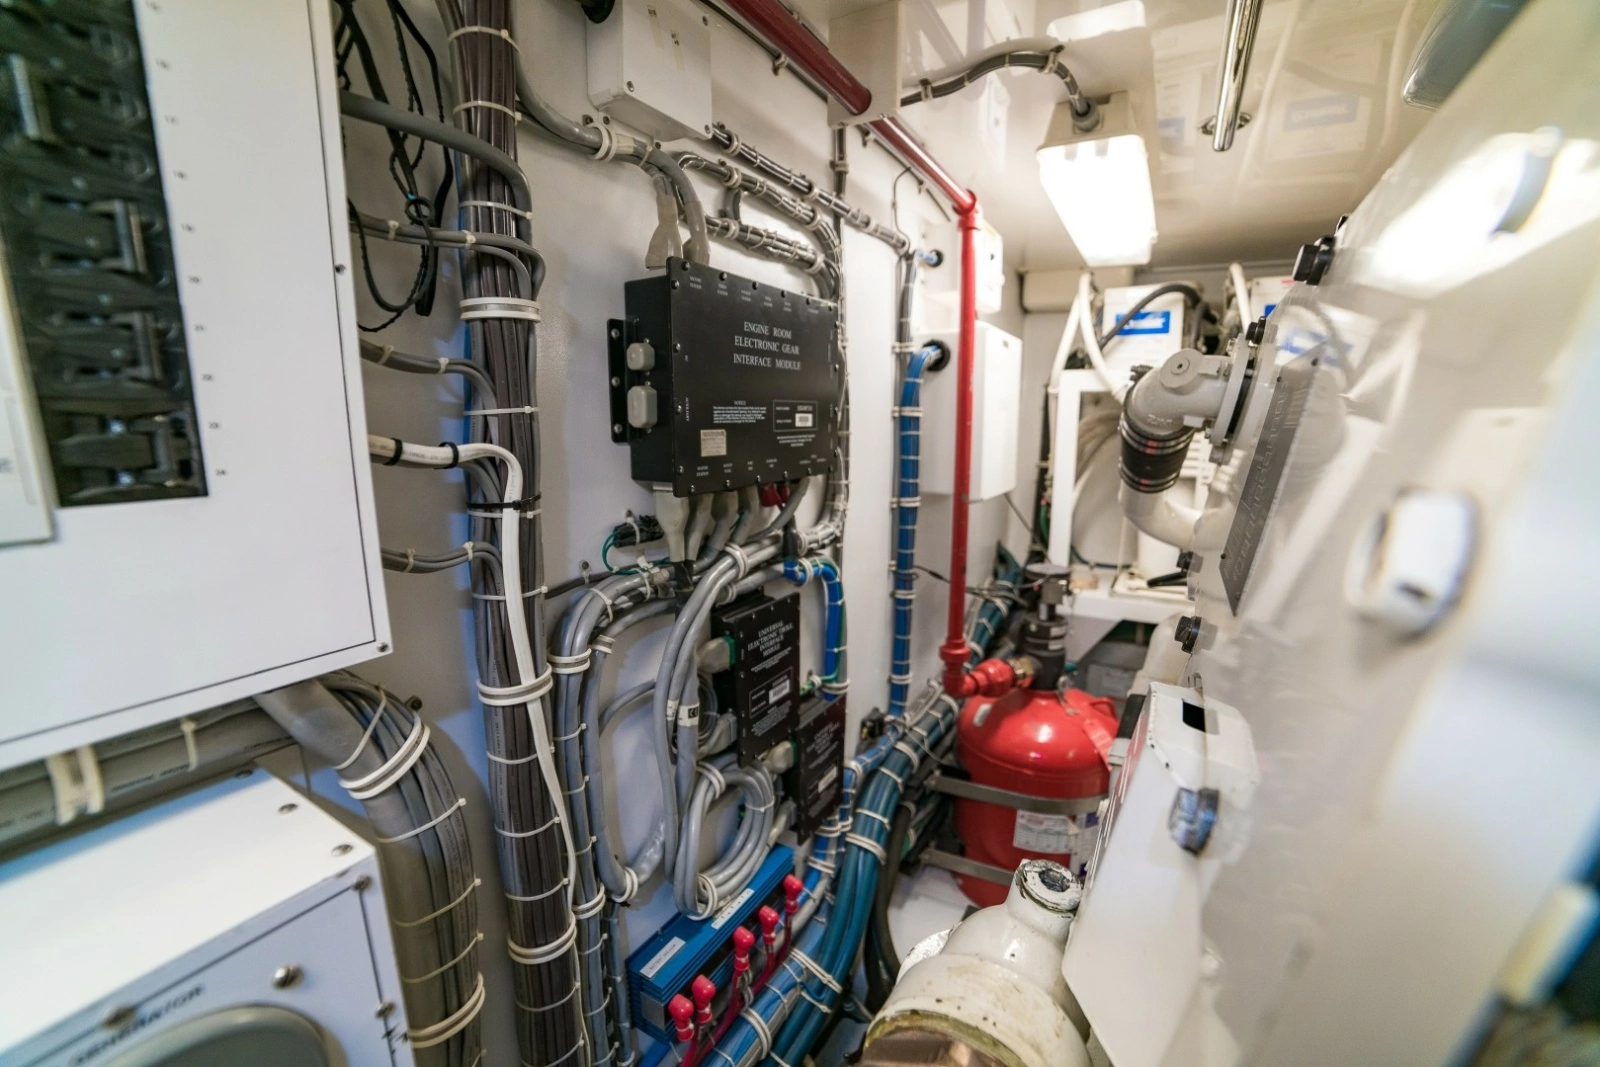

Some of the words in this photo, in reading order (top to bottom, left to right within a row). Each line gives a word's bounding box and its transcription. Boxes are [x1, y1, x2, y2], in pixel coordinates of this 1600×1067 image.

[744, 321, 769, 335] ENGINE
[773, 327, 792, 339] ROOM
[734, 335, 780, 352] ELECTRONIC
[781, 343, 800, 355] GEAR
[733, 353, 772, 367] INTERFACE
[775, 358, 802, 371] MODULE
[758, 620, 783, 637] UNIVERSAL
[747, 630, 777, 651] ELECTRONIC
[760, 634, 784, 651] INTERFACE
[762, 643, 780, 658] MODULE
